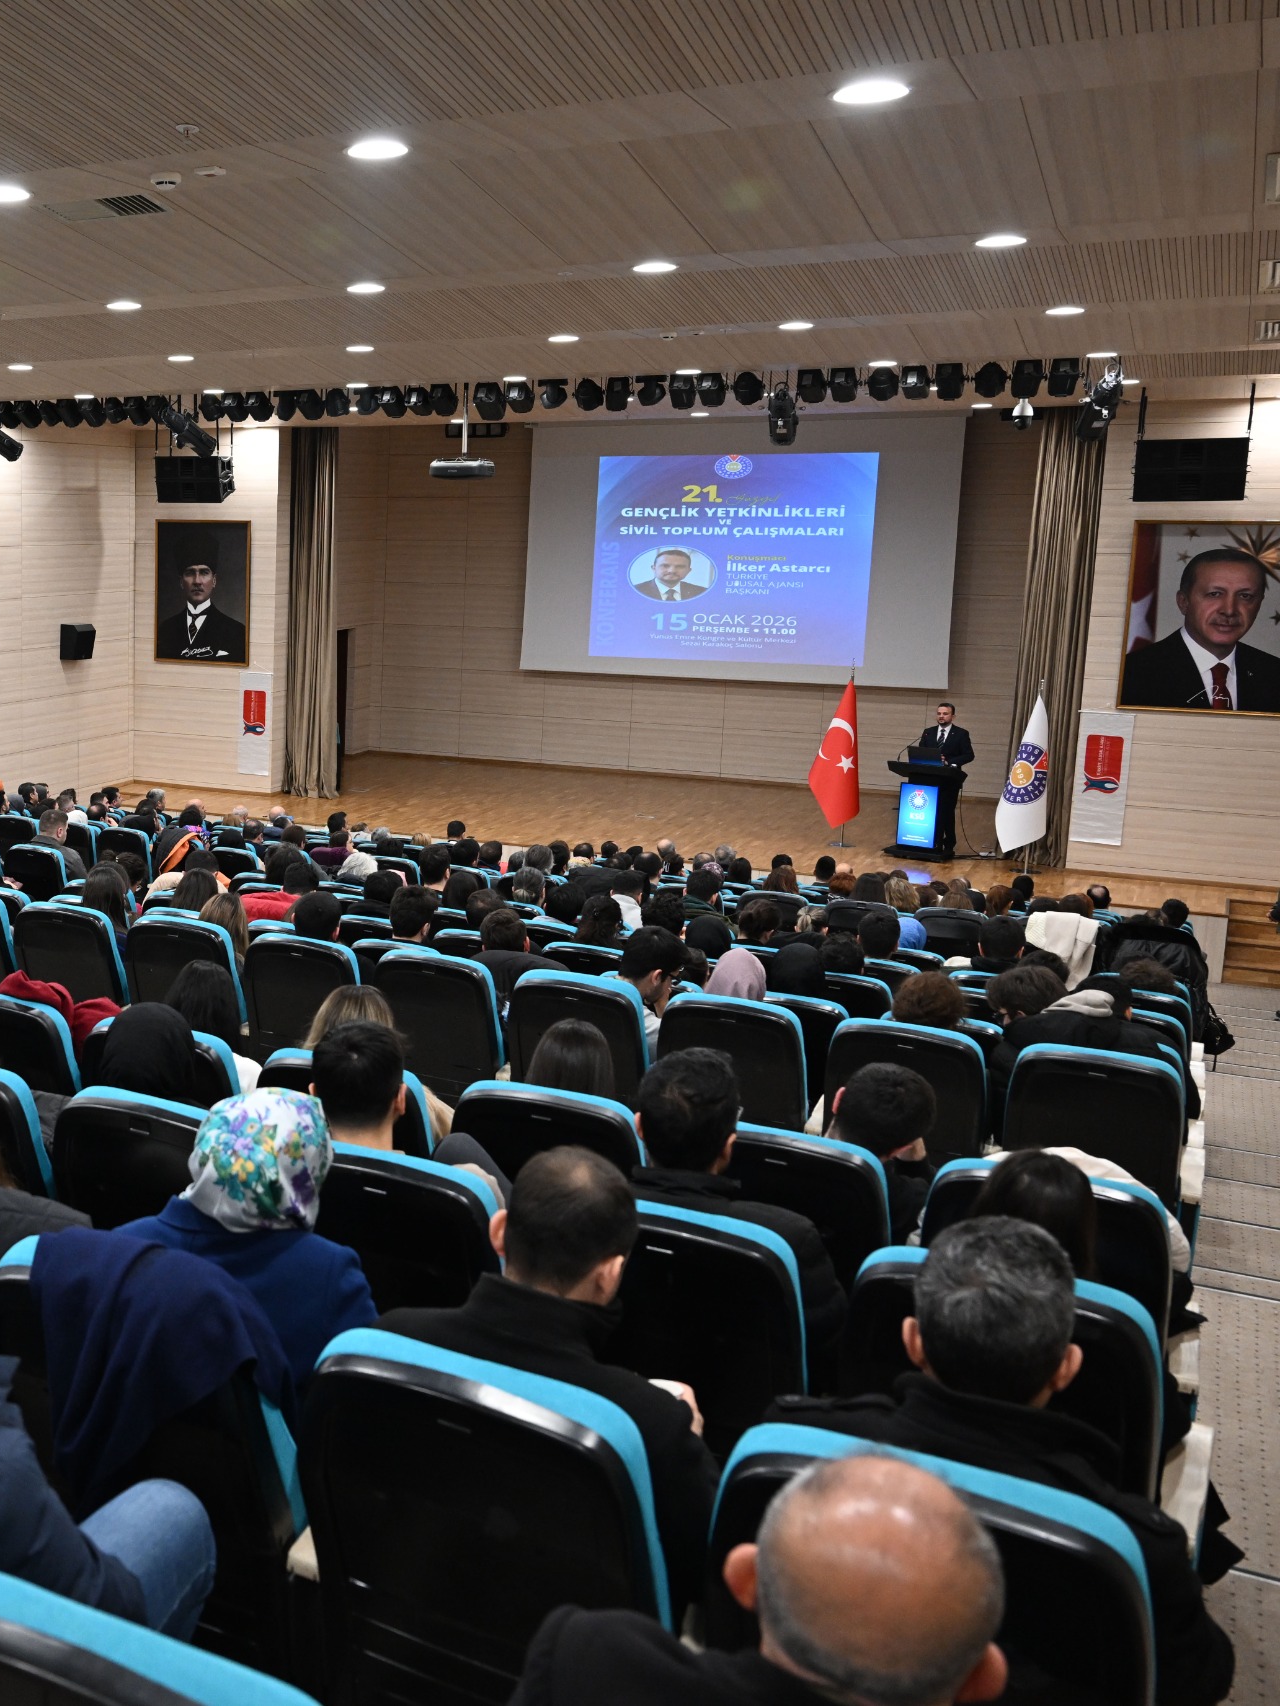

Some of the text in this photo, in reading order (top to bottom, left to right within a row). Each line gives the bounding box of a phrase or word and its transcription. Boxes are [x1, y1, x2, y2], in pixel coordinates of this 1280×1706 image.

[681, 485, 722, 503] 21.
[621, 505, 845, 520] GENÇLİK YETKİNLİKLERİ
[620, 525, 844, 538] SİVİL TOPLUM ÇALIŞMALARI
[726, 561, 831, 573] İlker Astarcı
[596, 541, 620, 646] KONFERANS
[650, 613, 797, 631] 15 OCAK 2026
[692, 626, 796, 635] PERŞEMBE 11.00
[1015, 763, 1027, 785] 1992
